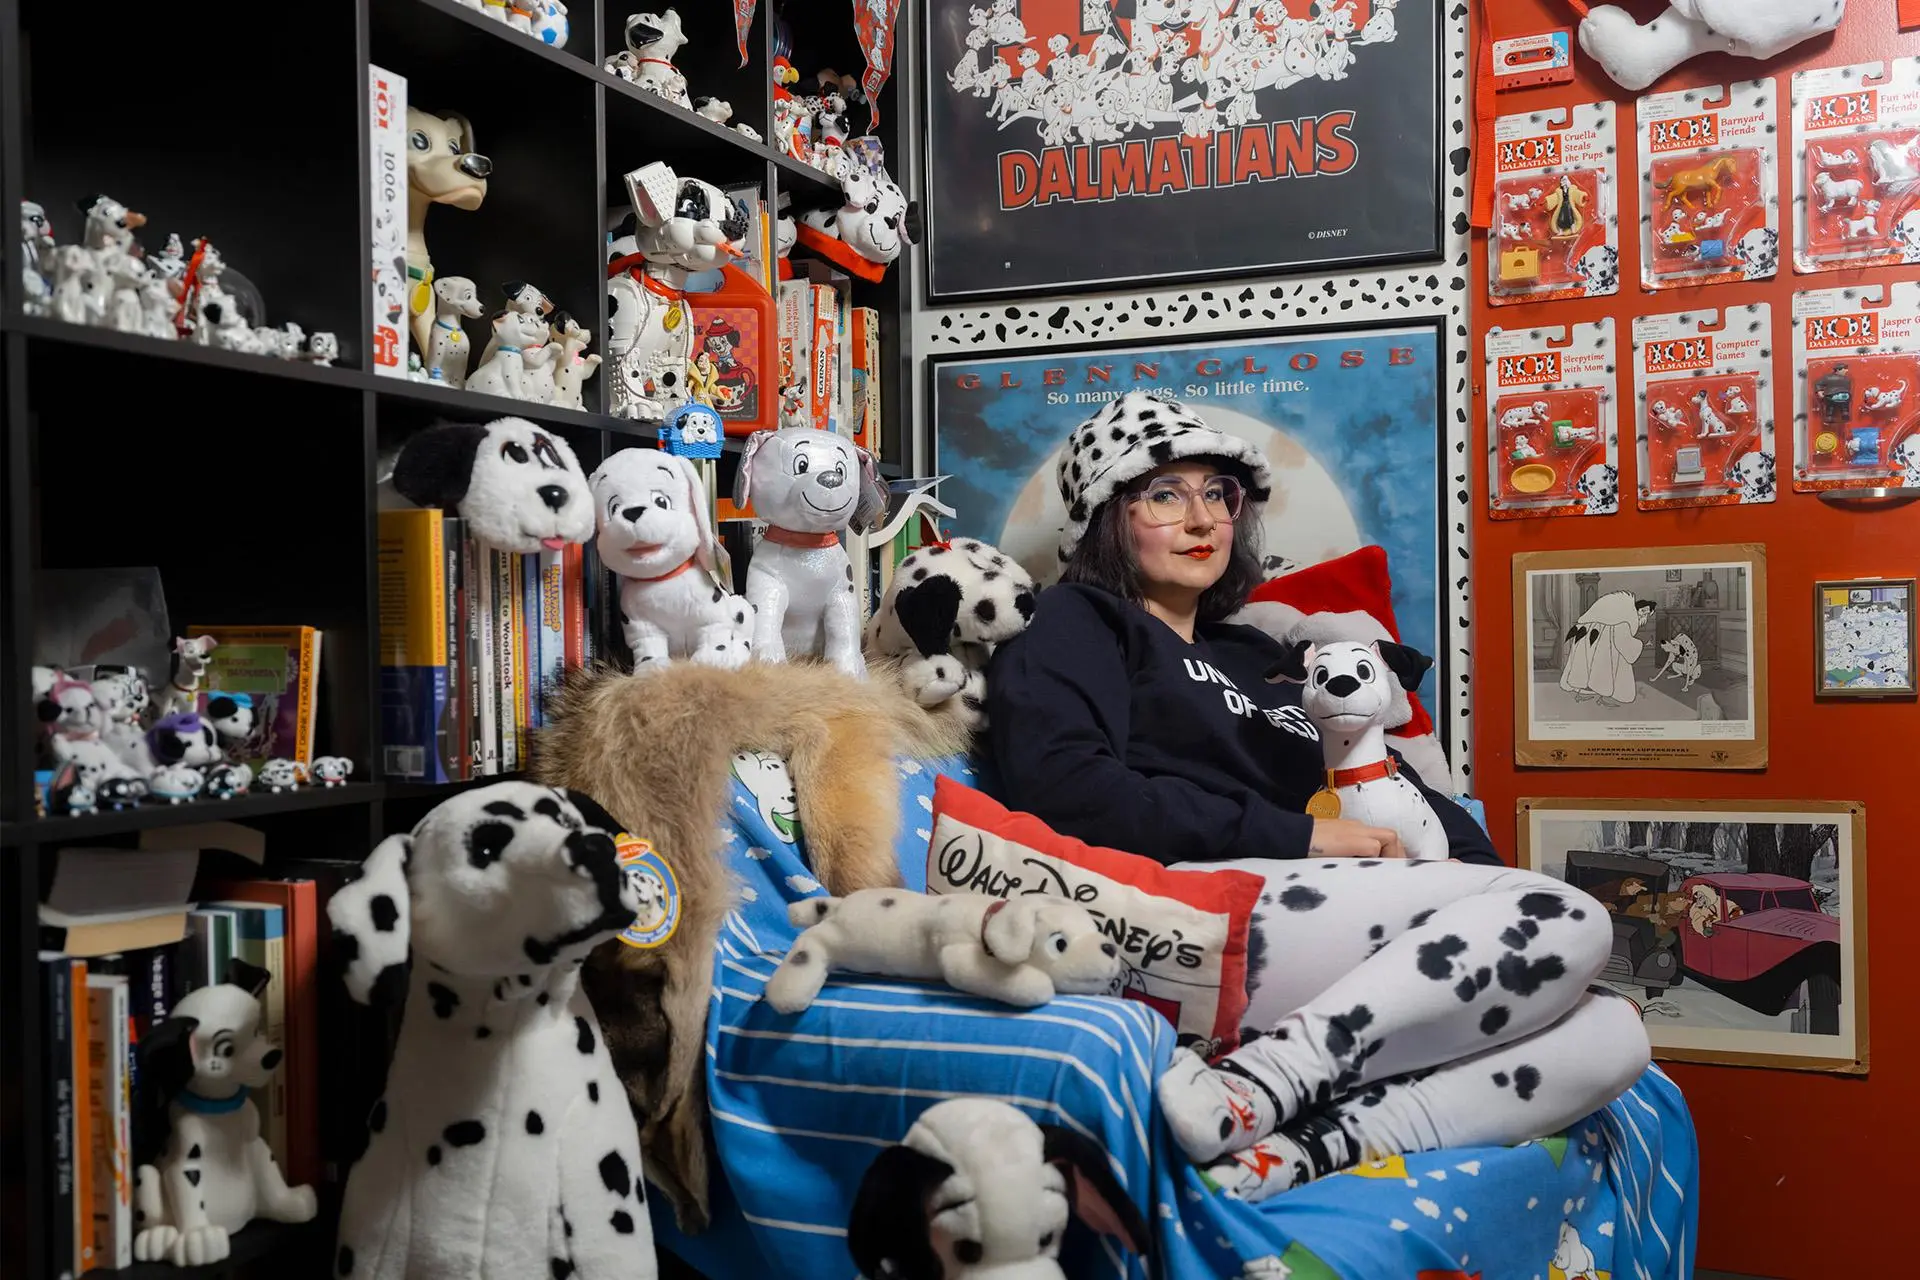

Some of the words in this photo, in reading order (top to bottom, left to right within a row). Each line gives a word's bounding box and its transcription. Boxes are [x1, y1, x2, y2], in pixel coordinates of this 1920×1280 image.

[377, 80, 389, 130] 101
[1811, 92, 1871, 121] 101
[1881, 94, 1899, 104] Fun
[1881, 101, 1918, 114] Friends
[1721, 112, 1765, 127] Barnyard
[1808, 113, 1875, 128] DALMATIANS
[1565, 130, 1596, 142] Cruella
[1654, 116, 1713, 143] 101
[1721, 125, 1756, 137] Friends
[1502, 137, 1559, 163] 101
[1565, 142, 1591, 153] Steals
[1653, 135, 1717, 151] DALMATIANS
[998, 110, 1359, 211] DALMATIANS
[1501, 156, 1560, 171] DALMATIANS
[1565, 153, 1580, 163] the
[1582, 151, 1604, 162] Pups
[1316, 228, 1349, 239] DISNEY
[1812, 316, 1873, 341] 101
[1881, 317, 1911, 329] Jasper
[1809, 334, 1877, 349] DALMATIANS
[1882, 330, 1910, 339] Bitten
[1649, 338, 1711, 365] 101
[1715, 339, 1760, 353] Computer
[1563, 353, 1605, 364] Sleepytime
[1716, 351, 1746, 361] Games
[956, 360, 1161, 390] GLENN
[1196, 346, 1416, 377] CLOSE
[1502, 354, 1559, 379] 101
[1564, 364, 1582, 373] with
[1585, 363, 1604, 371] Mom
[1648, 359, 1712, 372] DALMATIANS
[1501, 373, 1560, 386] DALMATIANS
[1047, 391, 1069, 405] So
[1075, 389, 1125, 404] many
[1184, 384, 1209, 398] So
[1215, 380, 1256, 396] little
[1262, 379, 1310, 393] time.
[543, 570, 552, 626] CARTOONS
[550, 564, 562, 632] HOLLYWOOD
[503, 604, 511, 617] to
[303, 632, 311, 673] MOVIES
[503, 621, 512, 690] Woodstock
[1223, 688, 1258, 719] OF
[55, 1104, 71, 1159] Vampire
[57, 1161, 72, 1196] Film
